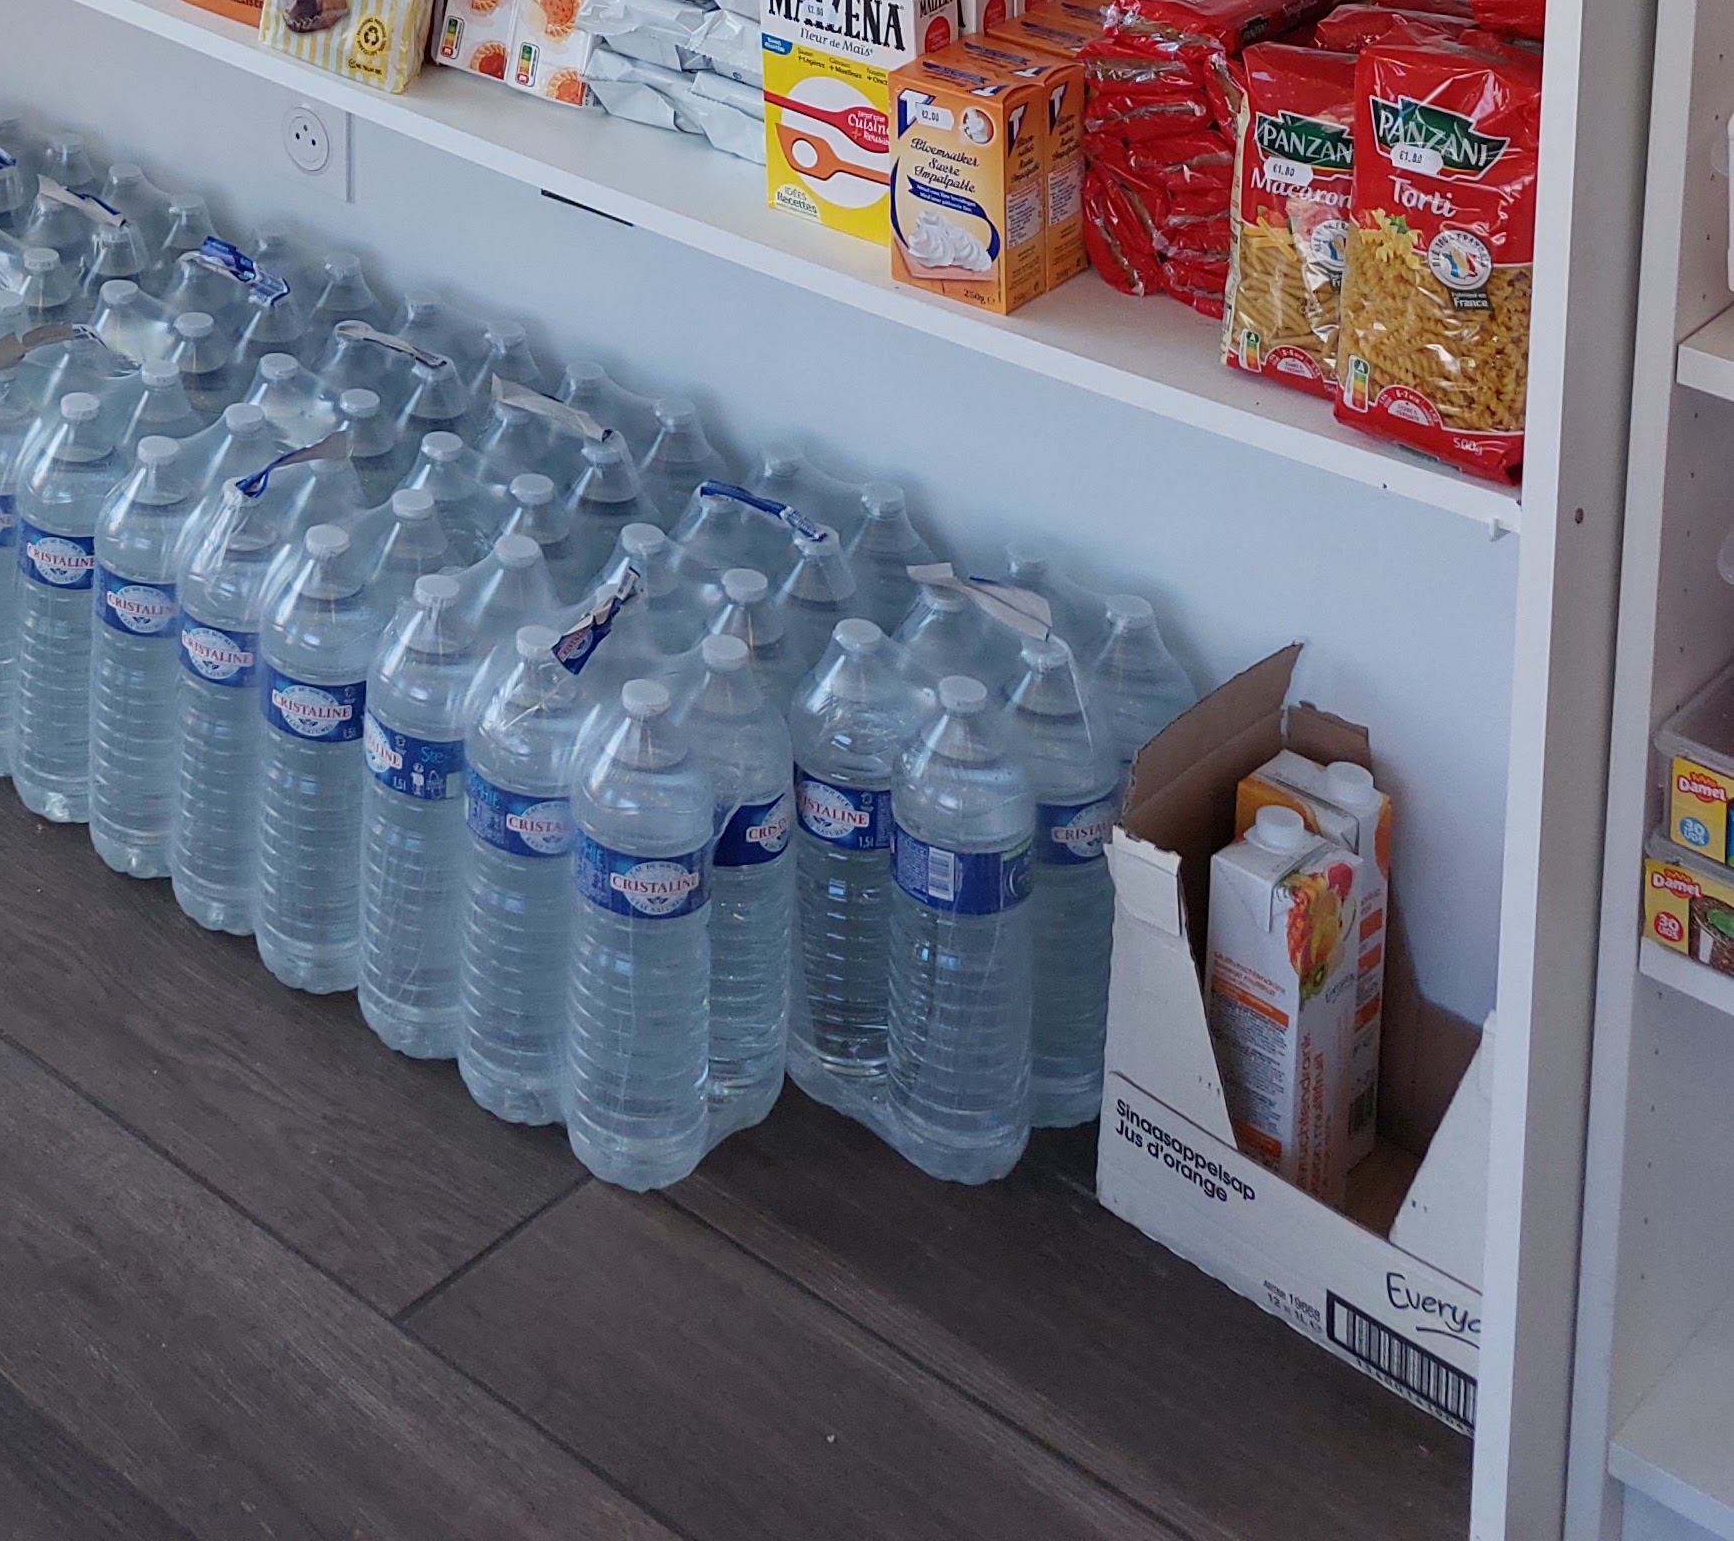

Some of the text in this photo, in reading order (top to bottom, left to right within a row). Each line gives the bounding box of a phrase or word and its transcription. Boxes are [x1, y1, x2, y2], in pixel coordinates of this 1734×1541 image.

[800, 28, 826, 45] Fleur
[830, 37, 841, 48] de
[1379, 109, 1489, 166] PANZANI
[1390, 178, 1457, 217] Torti
[183, 640, 253, 667] CRISTALINE
[273, 693, 352, 721] CRISTALINE
[1677, 773, 1725, 801] Damel
[1651, 872, 1702, 895] Damel
[1116, 1098, 1256, 1200] Sinaasappelsap
[1116, 1120, 1229, 1204] Jus d'orange
